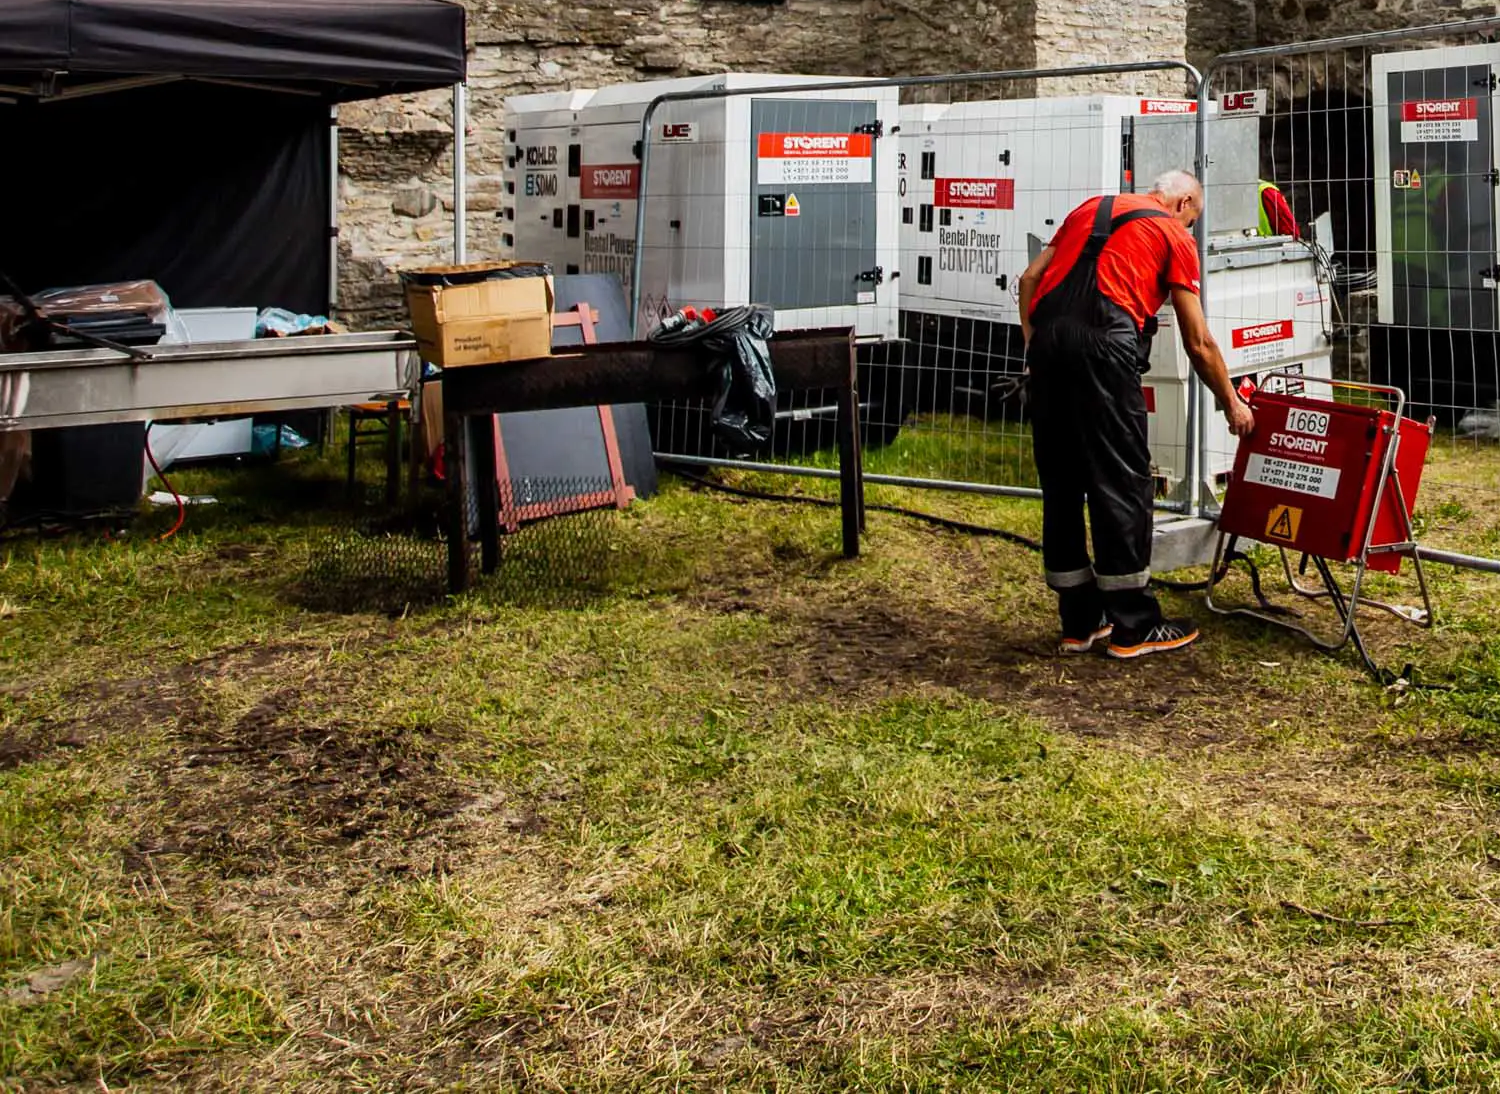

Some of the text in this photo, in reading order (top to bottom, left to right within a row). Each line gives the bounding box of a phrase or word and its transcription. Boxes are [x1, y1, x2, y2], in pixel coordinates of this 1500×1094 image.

[1147, 101, 1191, 112] STORENT
[1224, 92, 1254, 111] UC
[1416, 102, 1460, 113] STORENT
[783, 136, 848, 149] STORENT
[526, 146, 557, 165] KOHLER
[535, 173, 557, 196] SDMO
[593, 168, 632, 186] STORENT
[950, 182, 997, 198] STORENT
[584, 232, 609, 252] Rental
[939, 228, 1000, 248] Rental Power
[939, 247, 1000, 274] COMPACT
[454, 335, 481, 343] Product
[1242, 324, 1282, 340] STORENT
[1289, 411, 1328, 434] 1669
[1269, 432, 1328, 454] STORENT
